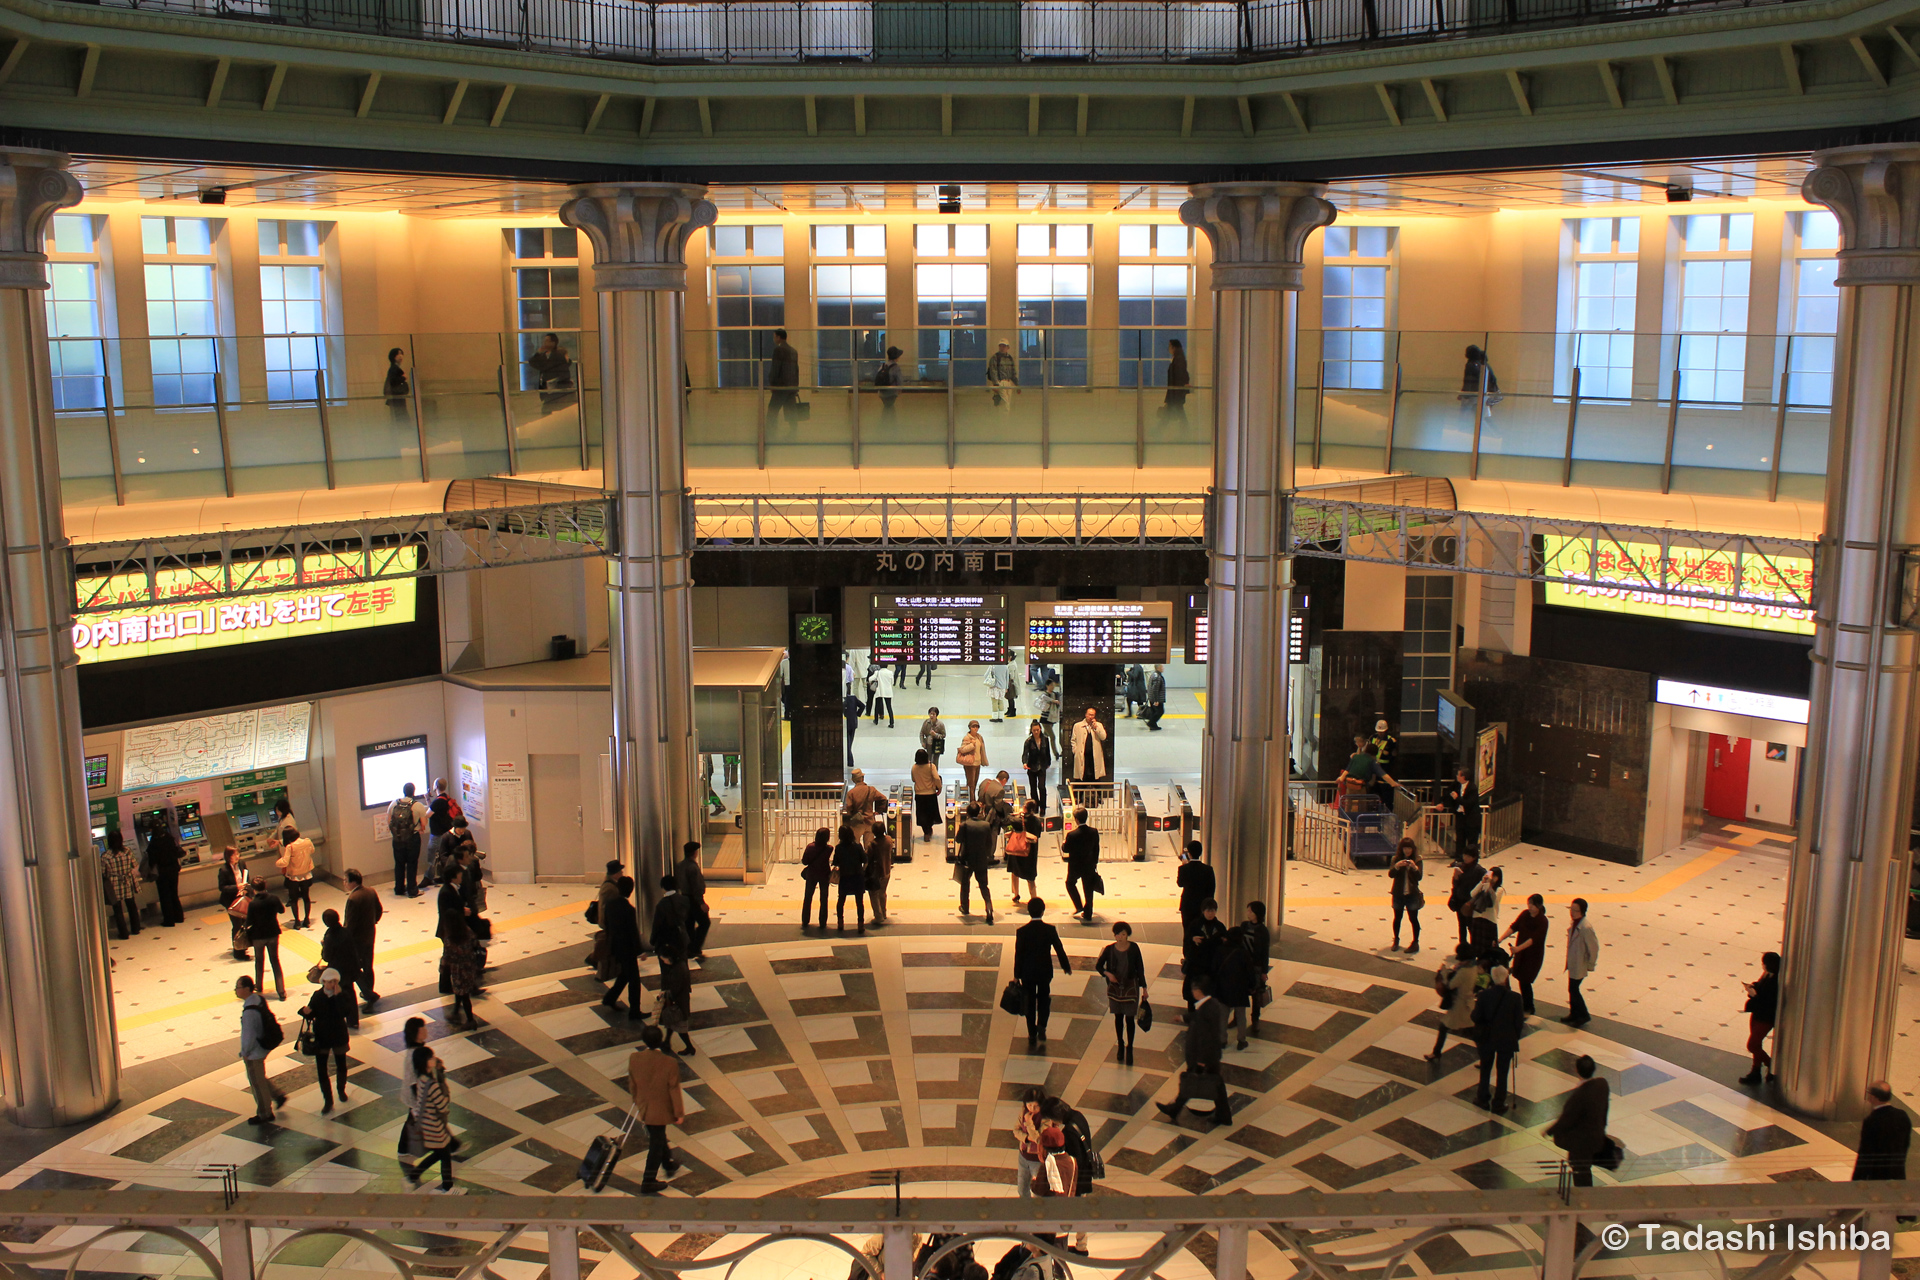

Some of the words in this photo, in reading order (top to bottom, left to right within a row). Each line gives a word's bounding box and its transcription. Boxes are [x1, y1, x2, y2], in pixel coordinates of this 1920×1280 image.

[876, 551, 1014, 572] 丸の内南口
[1564, 570, 1815, 621] 「丸の内南出口」改札を
[388, 740, 406, 748] TICKET
[703, 796, 720, 805] JR
